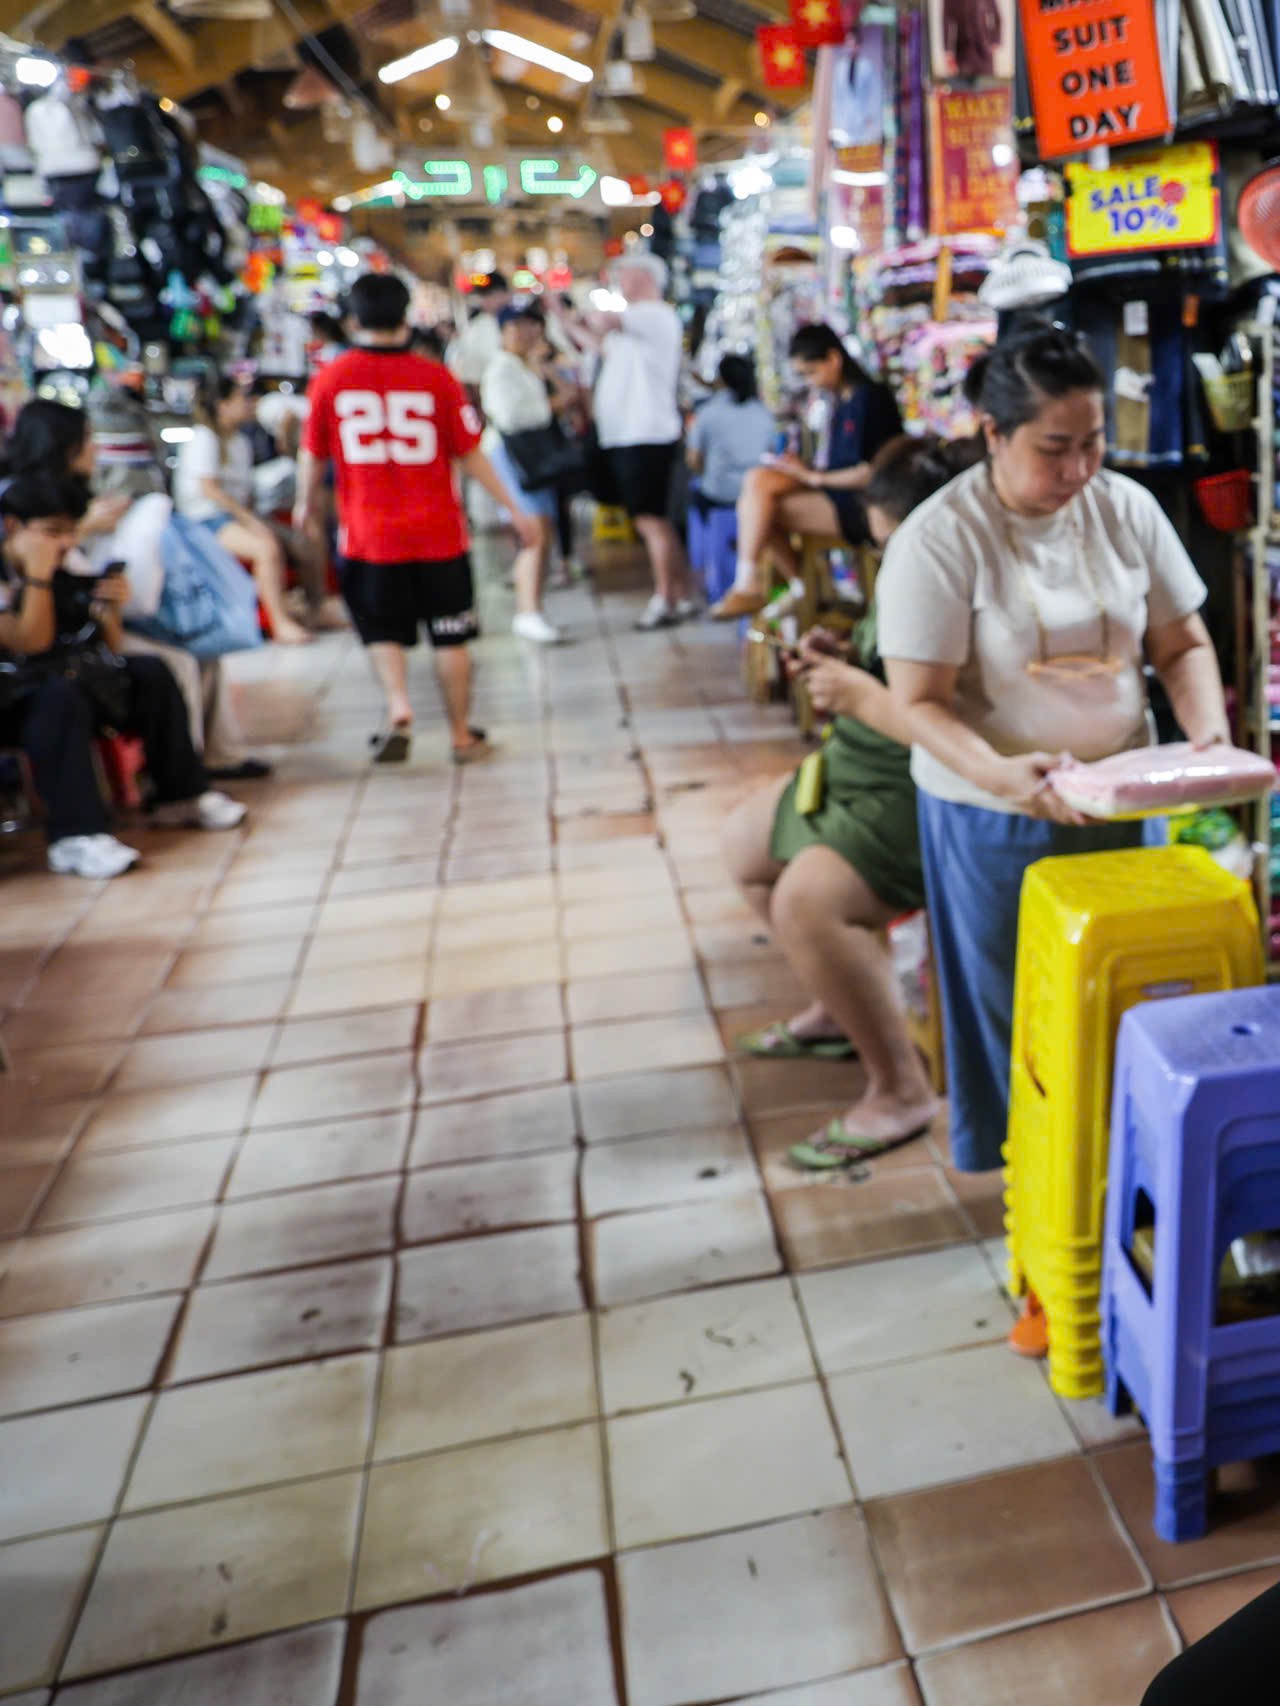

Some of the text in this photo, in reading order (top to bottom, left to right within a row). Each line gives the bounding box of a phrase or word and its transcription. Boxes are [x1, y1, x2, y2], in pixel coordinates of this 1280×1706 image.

[1053, 16, 1128, 55] SUIT
[1061, 60, 1134, 97] ONE
[1069, 102, 1141, 144] DAY
[1090, 177, 1160, 212] SALE
[1110, 206, 1178, 232] 10%
[335, 390, 437, 464] 25
